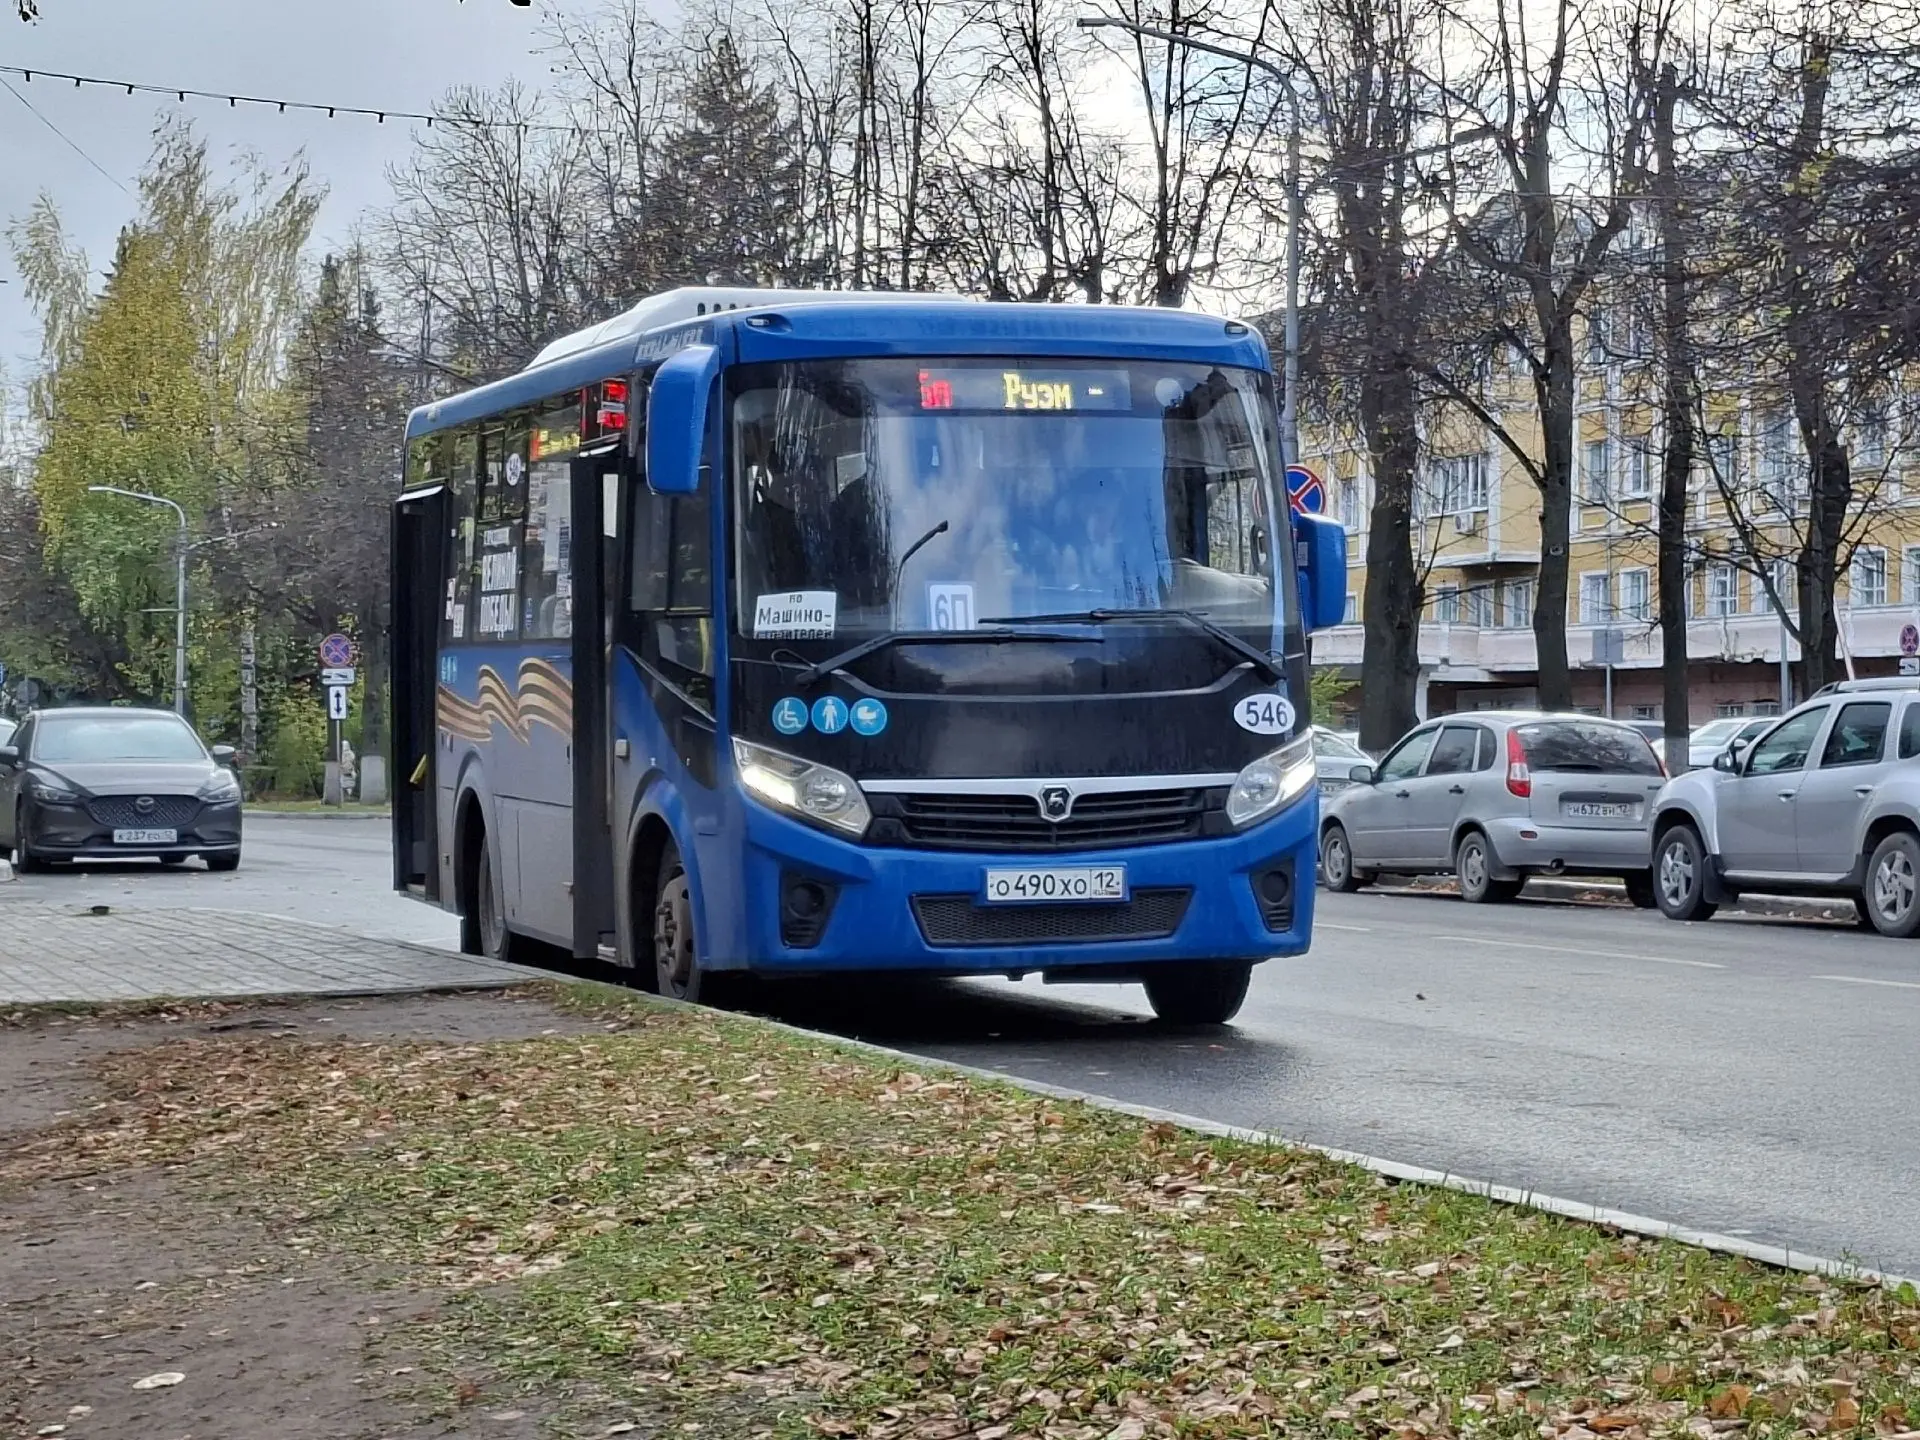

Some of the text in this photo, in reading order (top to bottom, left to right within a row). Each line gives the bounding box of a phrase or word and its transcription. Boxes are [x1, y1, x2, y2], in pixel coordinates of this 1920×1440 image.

[1004, 373, 1072, 409] Руэм
[758, 607, 832, 626] Машино-
[1246, 701, 1288, 727] 546
[1094, 872, 1115, 891] 12
